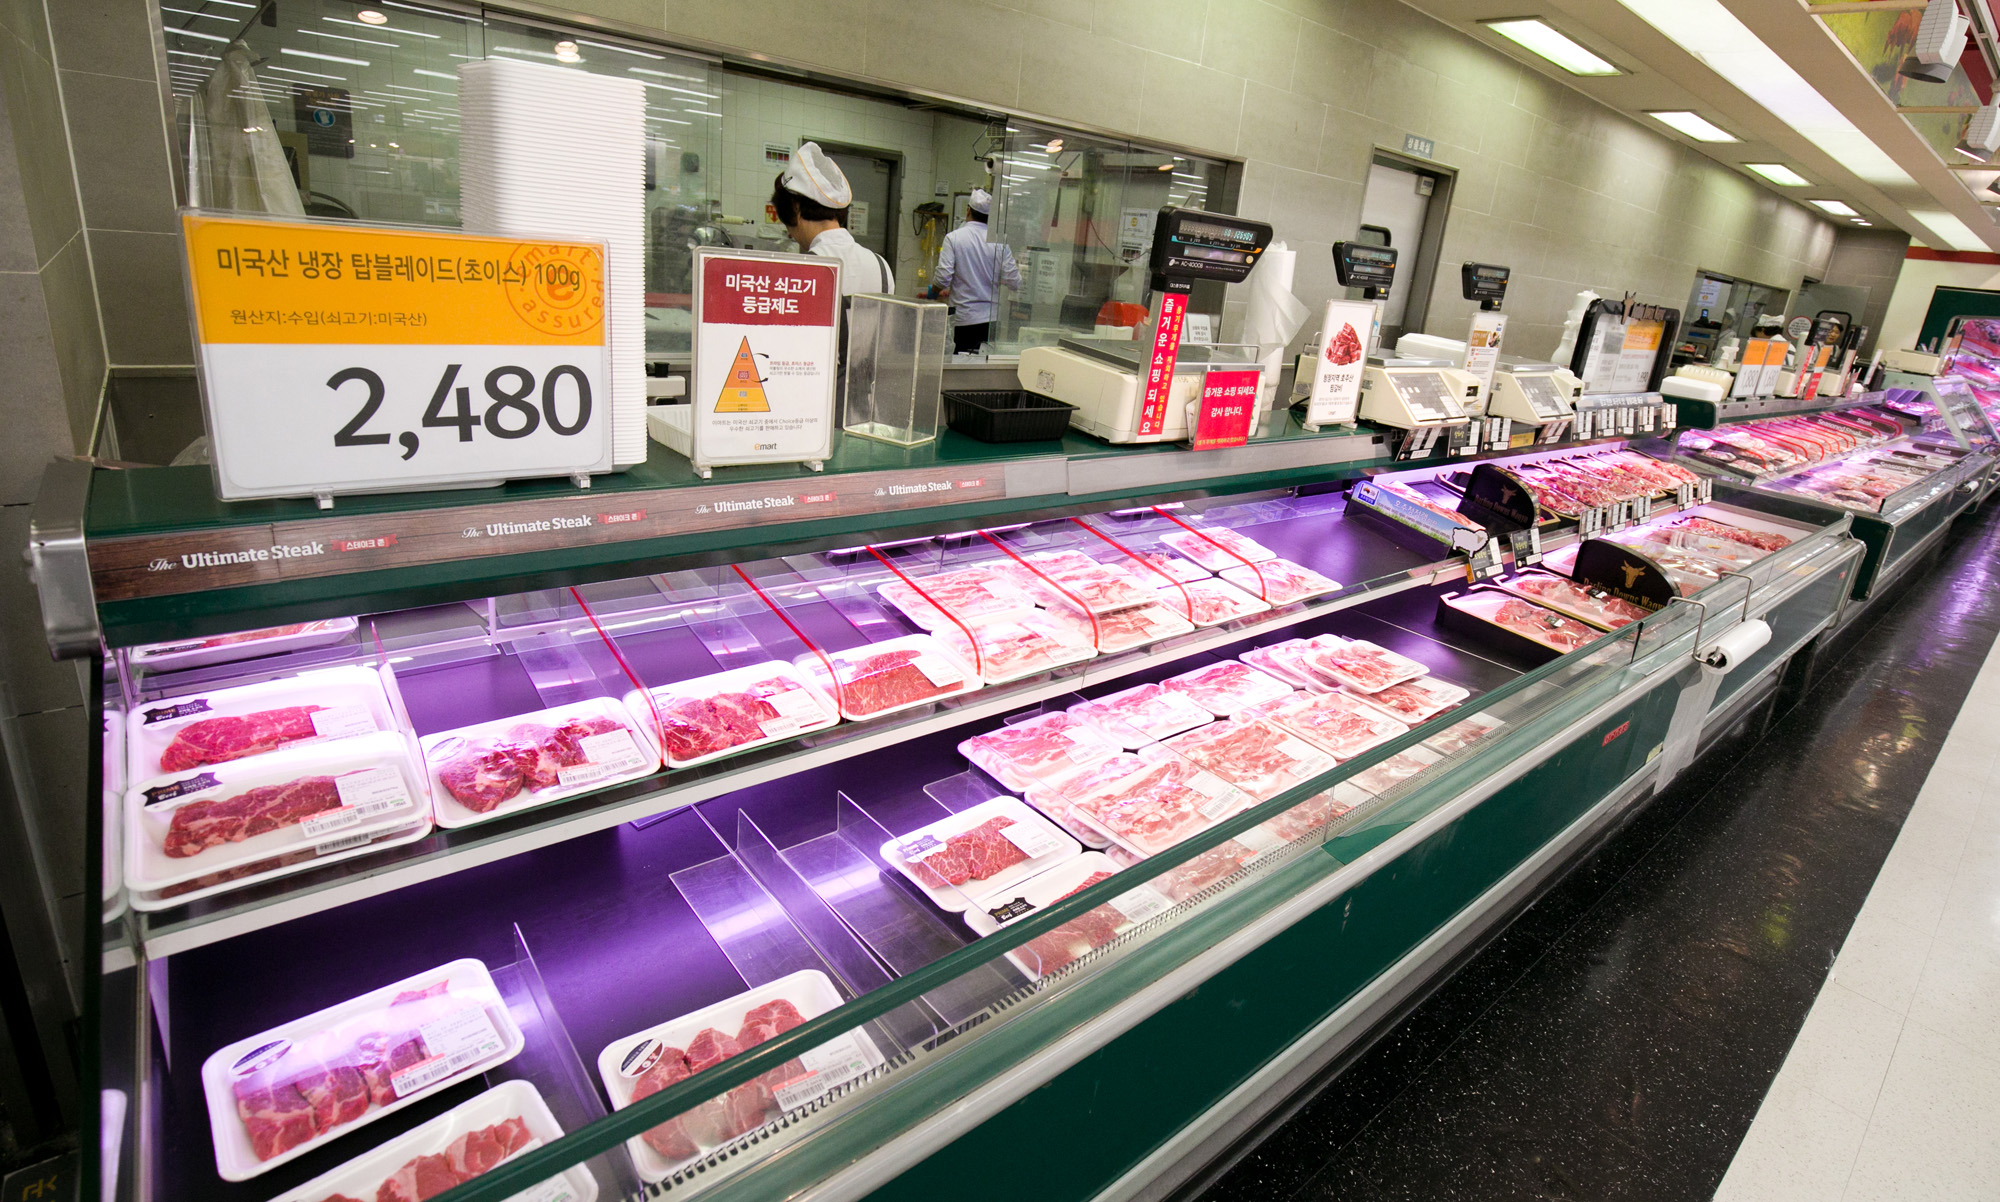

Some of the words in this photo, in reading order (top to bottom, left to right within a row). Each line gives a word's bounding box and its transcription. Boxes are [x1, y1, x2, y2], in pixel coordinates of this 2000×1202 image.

[217, 246, 289, 277] 미국산
[298, 250, 343, 280] 냉장
[351, 254, 527, 286] 탑블레이드(초이스)
[534, 263, 580, 291] 100g
[725, 274, 770, 293] 미국산
[773, 277, 816, 296] 쇠고기
[742, 296, 799, 315] 등급제도
[1157, 298, 1175, 347] 즐거운
[1151, 352, 1164, 383] 쇼핑
[1204, 386, 1223, 397] 즐거운
[1223, 386, 1237, 396] 쇼핑
[325, 363, 593, 461] 2,480
[1140, 388, 1158, 433] 되세요
[874, 487, 888, 497] The
[888, 483, 928, 496] Ultimate
[927, 480, 952, 493] Steak
[695, 504, 712, 515] The
[713, 497, 764, 514] Ultimate
[763, 494, 795, 509] Steak
[461, 526, 483, 539] The
[486, 519, 551, 537] Ultimate
[551, 514, 592, 530] Steak
[147, 557, 177, 572] The
[181, 547, 269, 569] Ultimate
[271, 541, 324, 560] Steak
[346, 540, 376, 550] 스테이크
[1613, 587, 1640, 604] Downs
